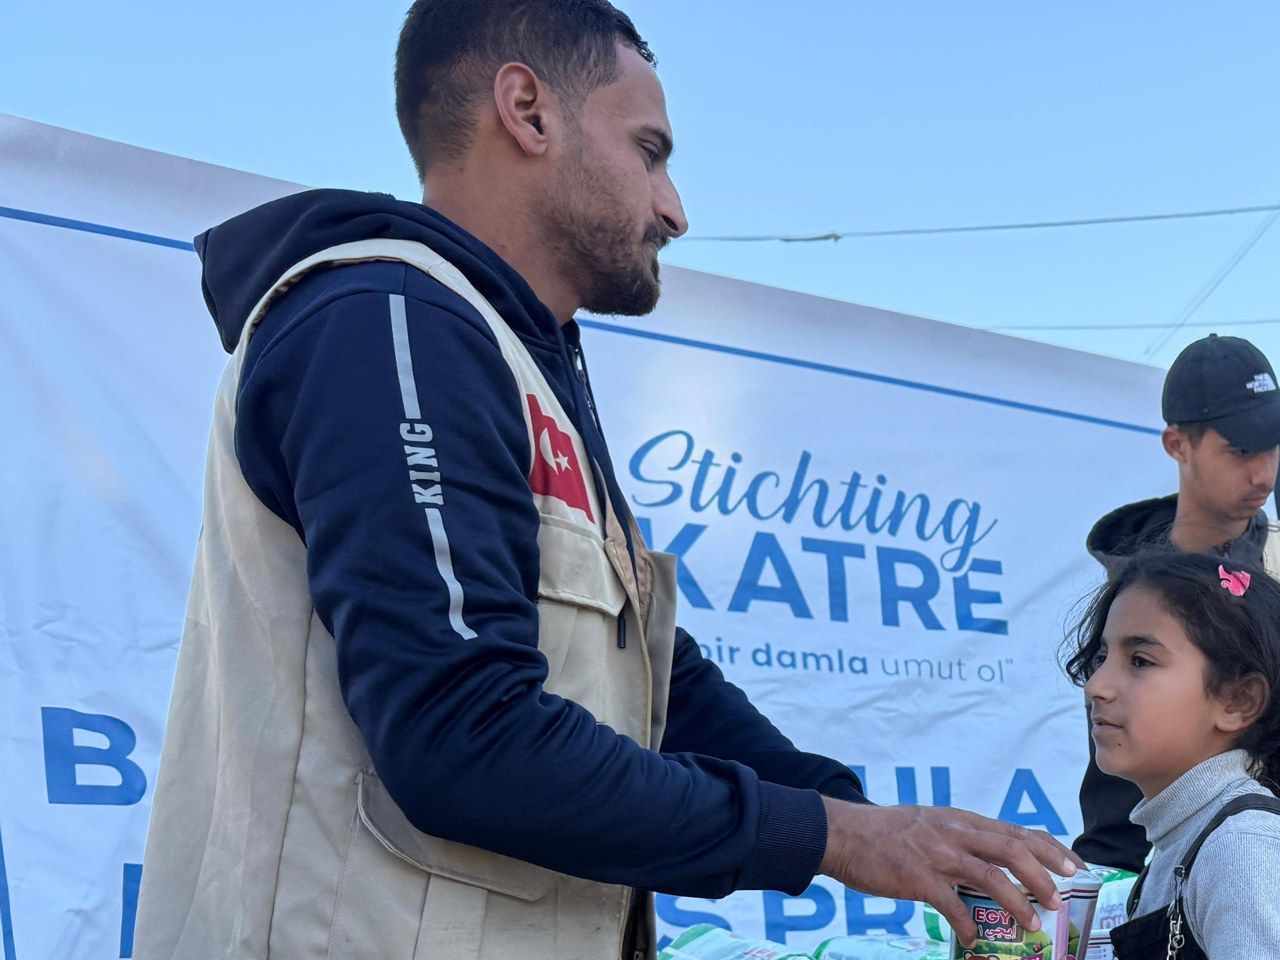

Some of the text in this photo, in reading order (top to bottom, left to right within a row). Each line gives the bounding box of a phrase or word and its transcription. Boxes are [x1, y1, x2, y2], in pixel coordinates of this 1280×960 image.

[400, 423, 444, 505] KING
[628, 429, 998, 574] Stichting
[635, 517, 1009, 636] KATRE
[751, 643, 869, 675] damla
[881, 657, 967, 682] umut
[976, 907, 1012, 925] EGY
